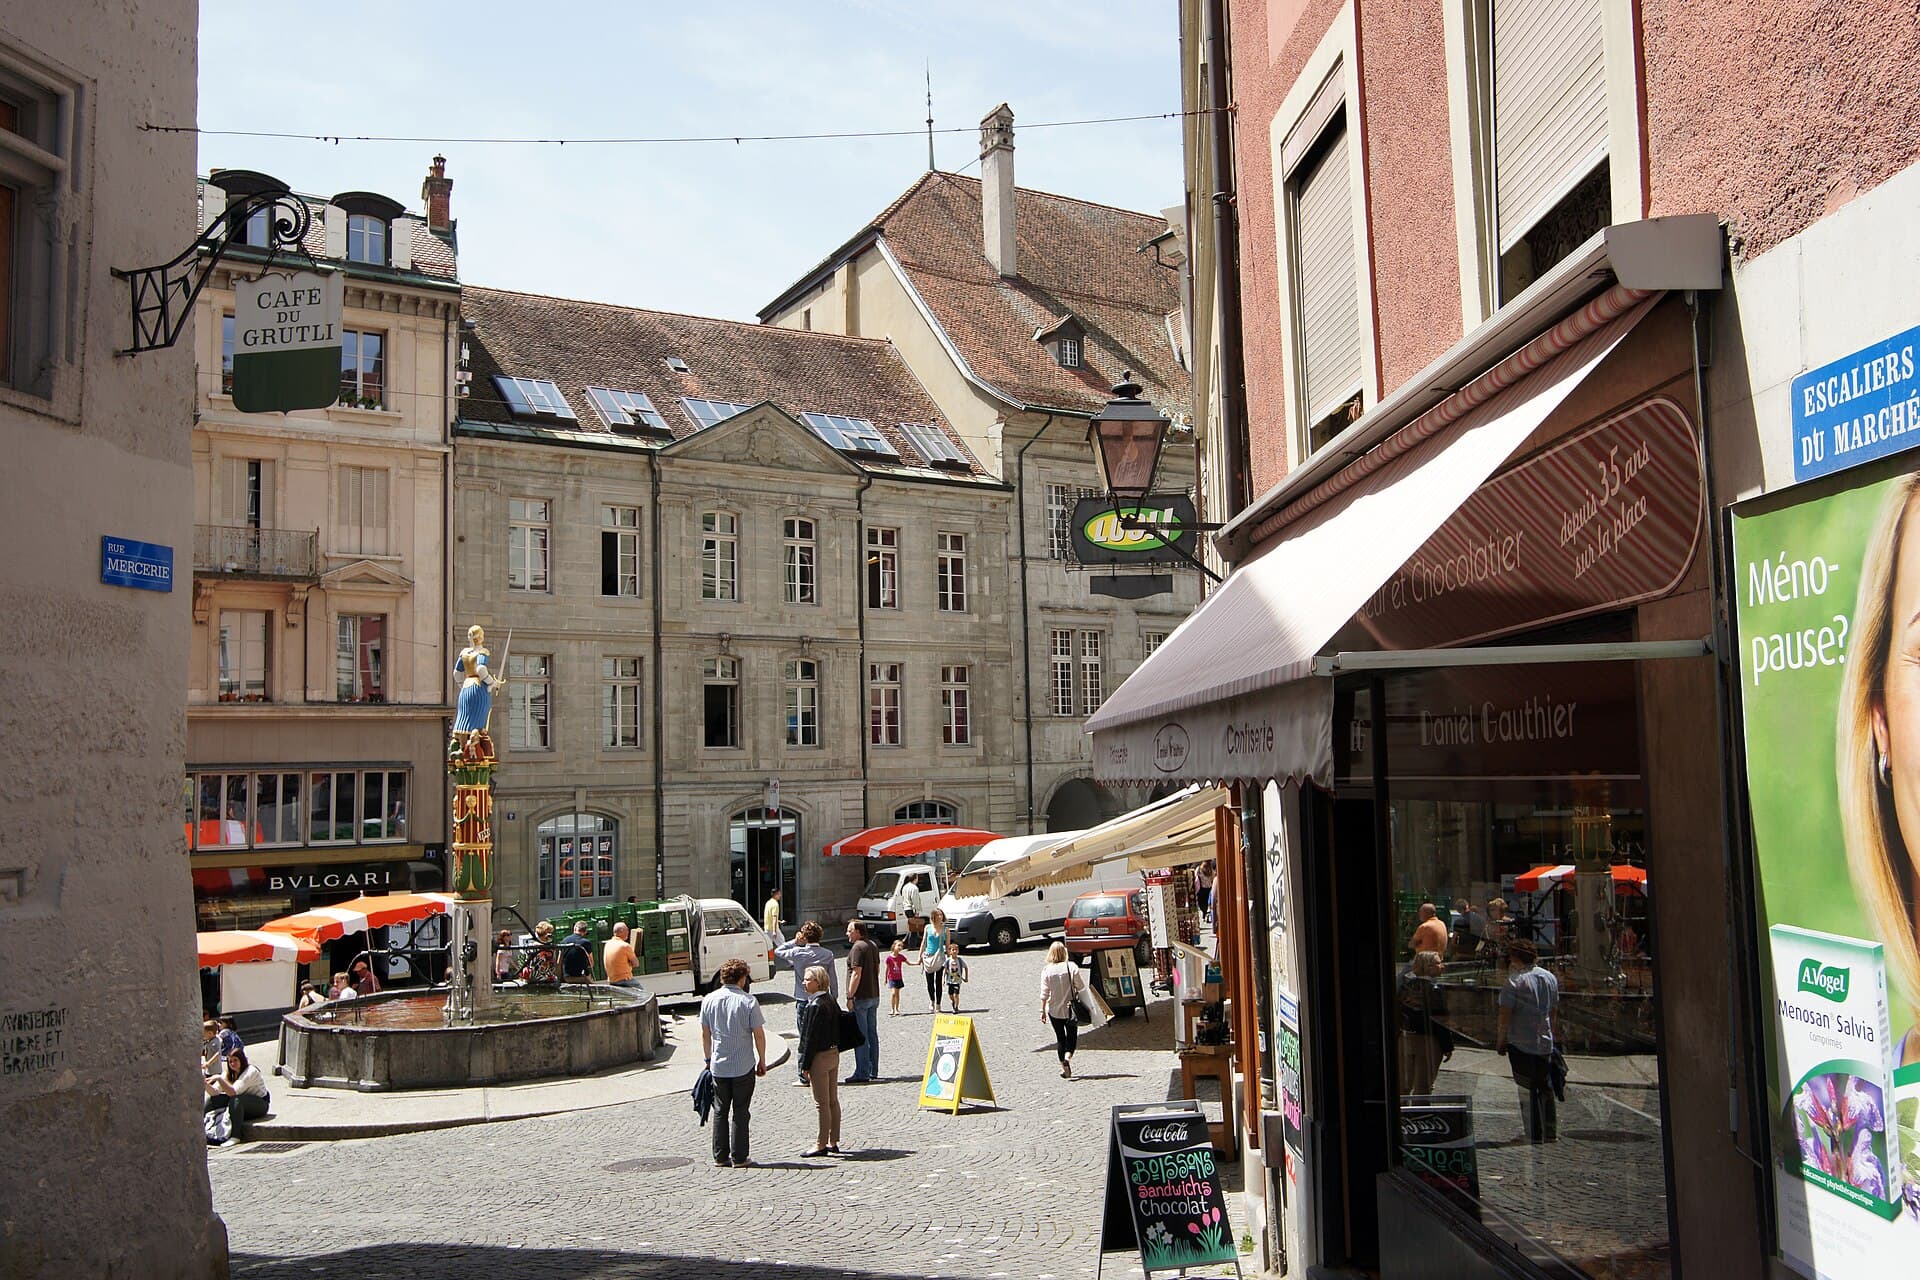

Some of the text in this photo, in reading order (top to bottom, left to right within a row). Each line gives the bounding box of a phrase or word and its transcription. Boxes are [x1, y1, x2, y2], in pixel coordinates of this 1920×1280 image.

[257, 287, 321, 309] CAFÉ
[276, 310, 301, 323] DU
[243, 323, 334, 346] GRUTLI
[1803, 345, 1914, 417] ESCALIERS
[1801, 389, 1920, 466] DU MARCHÉ
[1560, 440, 1650, 548] depuis 35 ans
[107, 543, 125, 554] RUE
[1575, 495, 1648, 580] sur la place
[107, 557, 170, 579] MERCERIE
[1391, 571, 1407, 609] et
[1411, 527, 1524, 603] Chocolatier
[1749, 551, 1840, 607] Méno-
[1752, 615, 1849, 686] pause?
[1421, 704, 1474, 746] Daniel
[1480, 692, 1577, 744] Gauthier
[1226, 720, 1274, 754] Confiserie
[270, 872, 391, 890] BVLGARI
[46, 1030, 62, 1048] ET
[1836, 1015, 1874, 1042] Salvia
[1139, 1195, 1210, 1216] Chocolat
